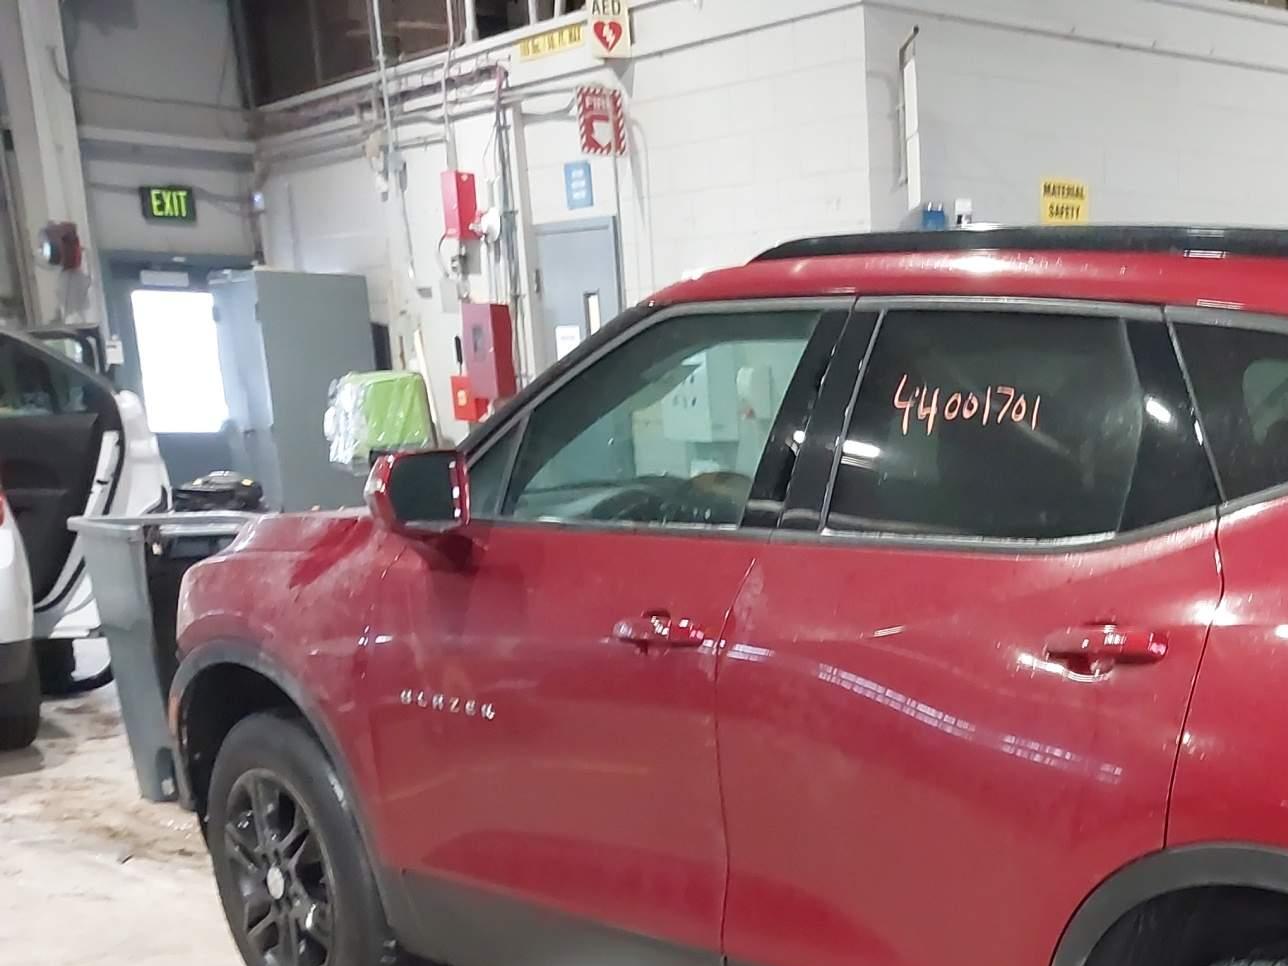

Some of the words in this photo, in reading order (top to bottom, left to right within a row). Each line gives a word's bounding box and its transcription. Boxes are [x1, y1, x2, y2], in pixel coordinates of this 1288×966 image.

[592, 0, 621, 15] AED
[1043, 182, 1084, 200] MATERIAL
[151, 190, 187, 217] EXIT
[1048, 203, 1081, 220] SAFETY
[894, 374, 1041, 436] 44001701
